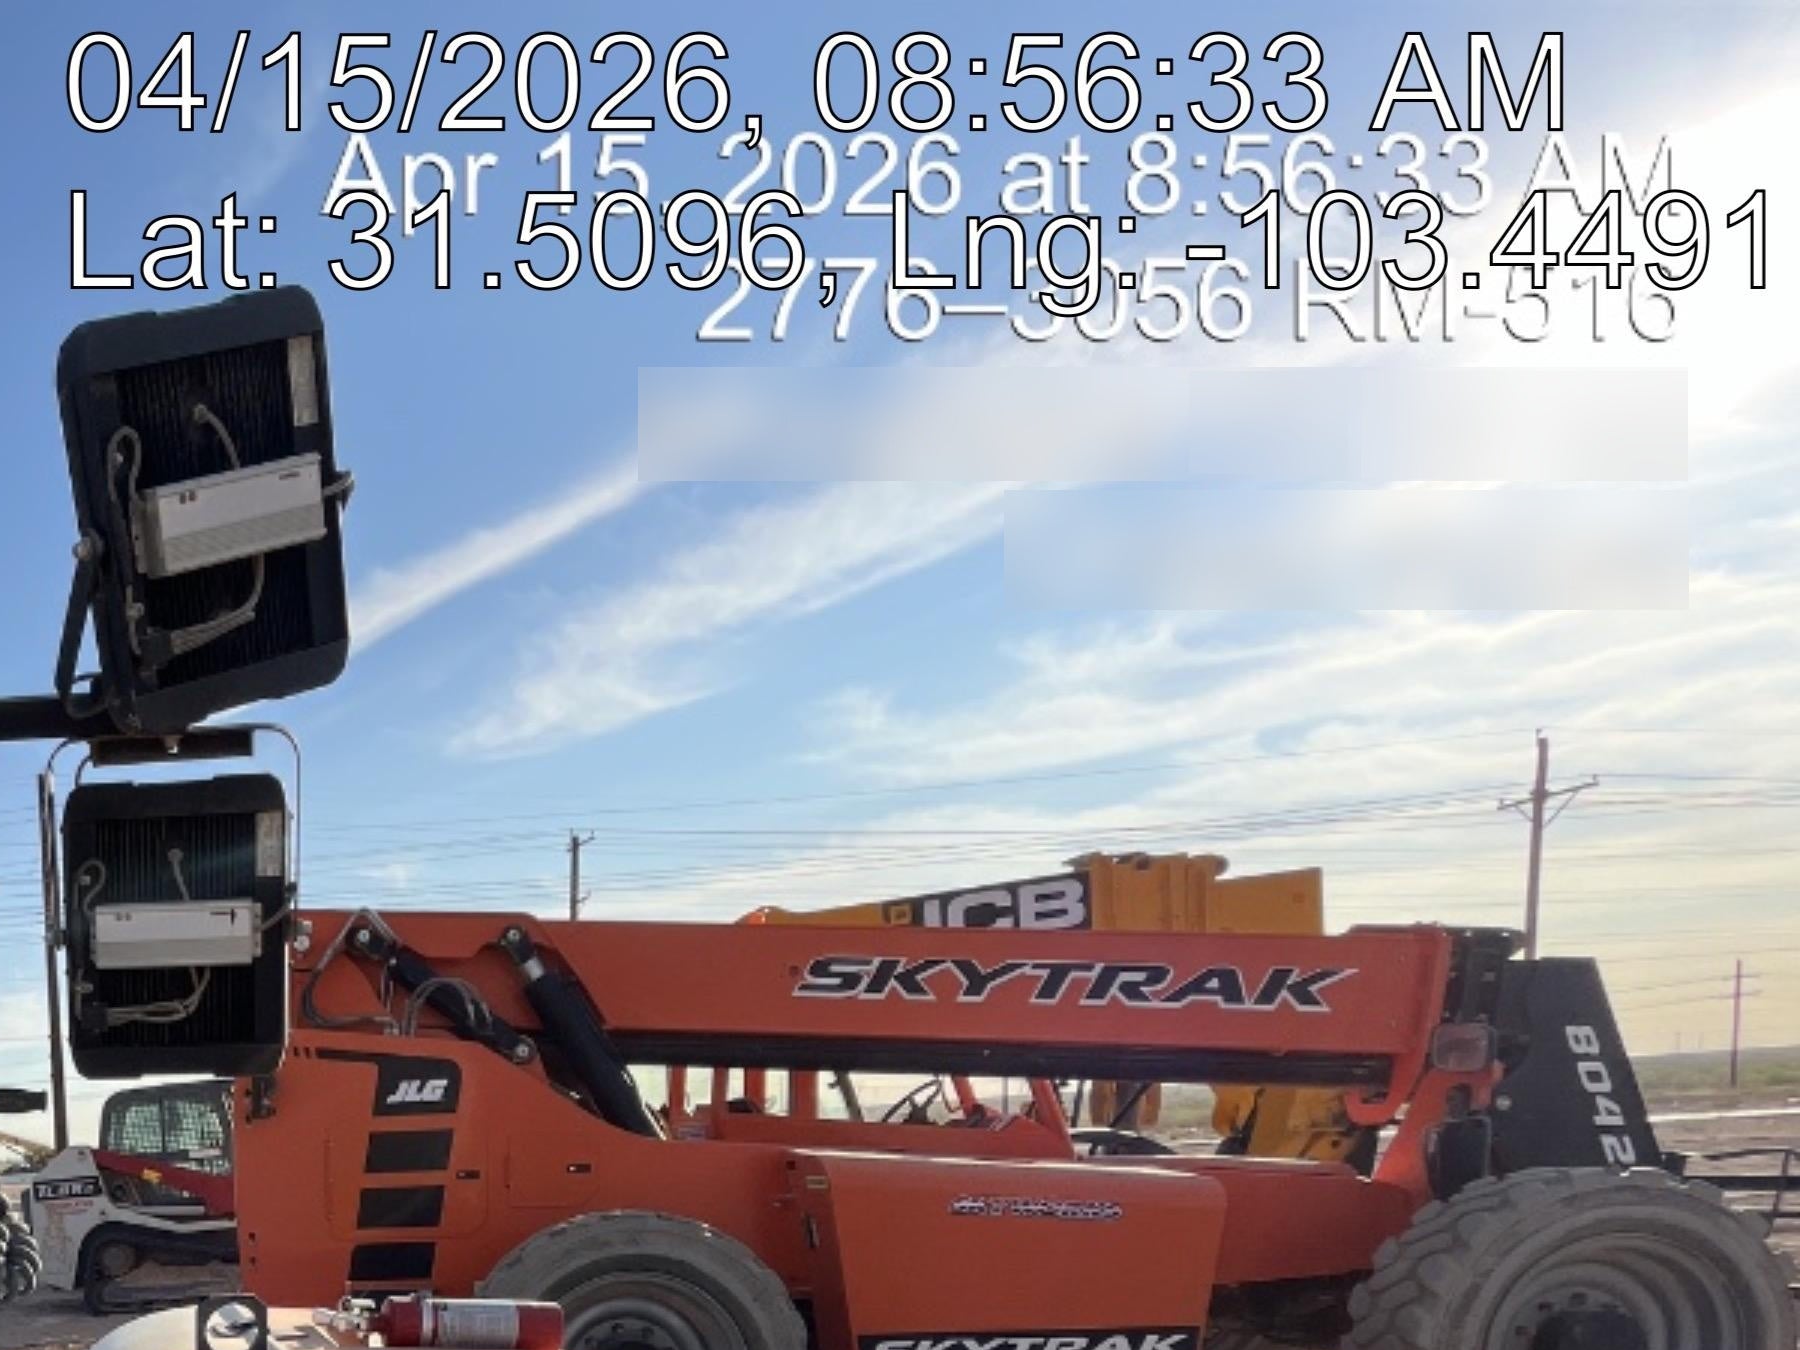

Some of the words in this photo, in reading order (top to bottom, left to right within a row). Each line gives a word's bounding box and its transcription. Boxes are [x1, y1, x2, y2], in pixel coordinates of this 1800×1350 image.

[791, 956, 1359, 1012] SKYTRAK
[386, 1079, 448, 1104] JLG
[1565, 1025, 1636, 1165] 8042
